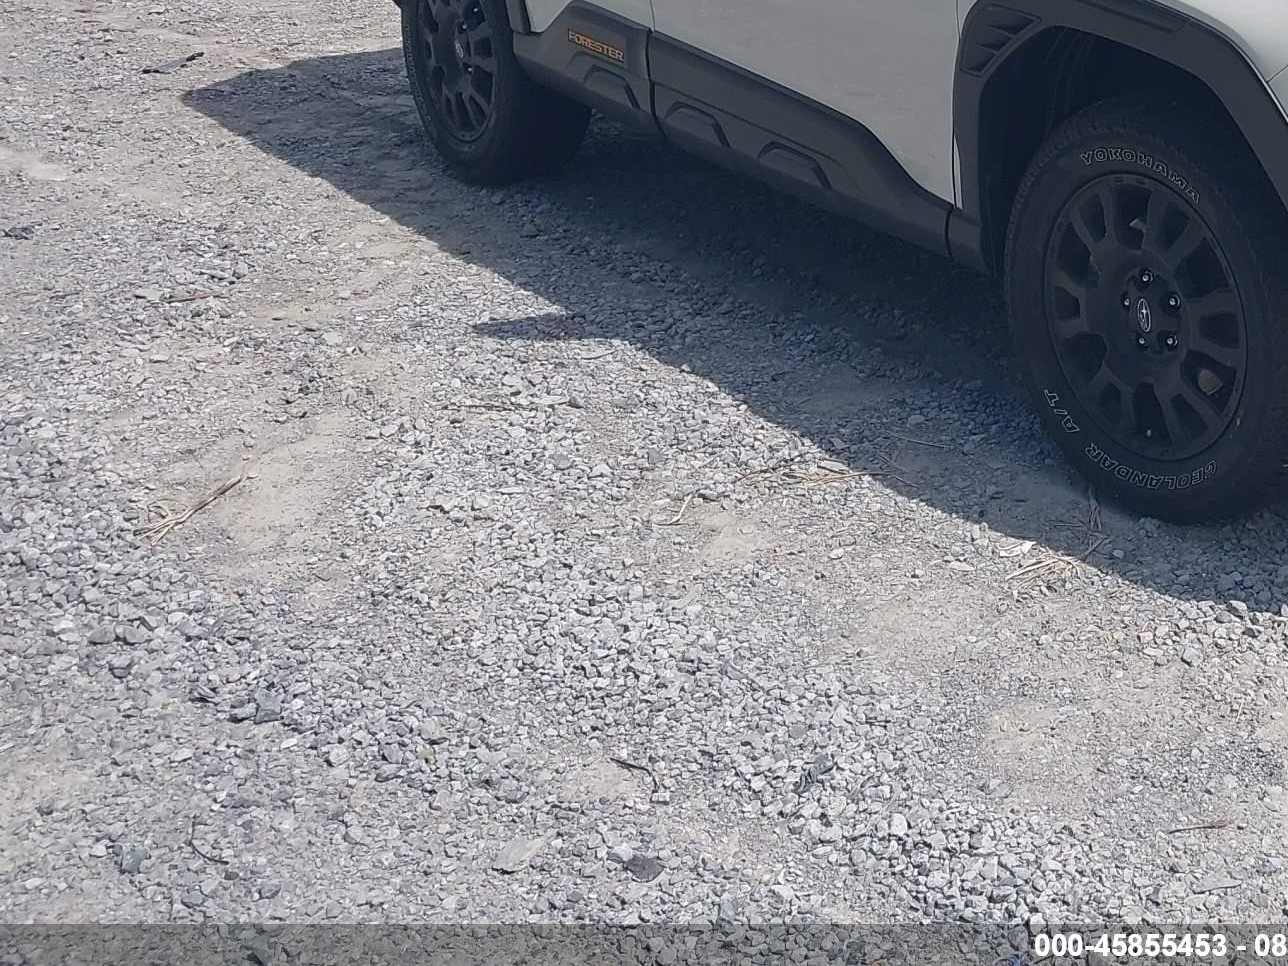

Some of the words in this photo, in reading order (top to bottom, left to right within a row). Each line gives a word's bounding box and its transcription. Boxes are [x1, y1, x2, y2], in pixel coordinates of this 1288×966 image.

[568, 30, 625, 62] FORESTER
[1080, 148, 1200, 204] YOKOHAMA
[1043, 389, 1080, 433] A/T
[1085, 442, 1217, 490] GEOLANDAR
